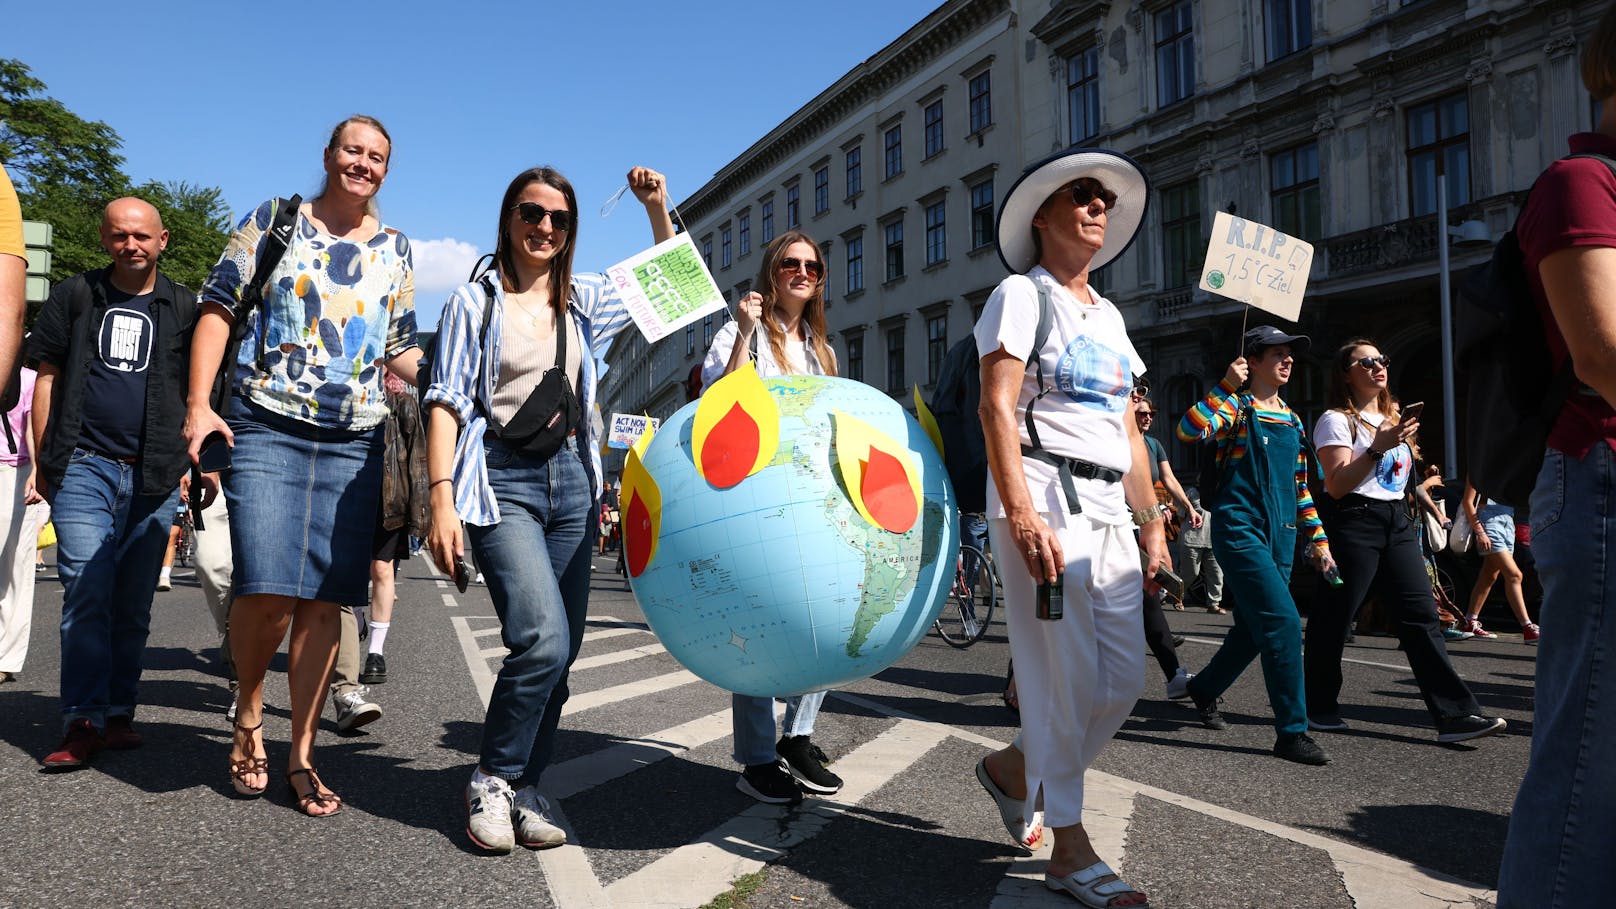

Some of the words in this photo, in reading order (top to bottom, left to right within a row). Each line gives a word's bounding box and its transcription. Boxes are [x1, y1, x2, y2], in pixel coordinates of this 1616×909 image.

[1227, 217, 1287, 259] R.I.P.
[610, 266, 632, 291] FOR
[628, 294, 663, 338] FUTURE!
[616, 417, 629, 426] ACT
[631, 418, 646, 427] NOW
[614, 426, 633, 434] SWIM
[882, 555, 919, 564] AMERICA
